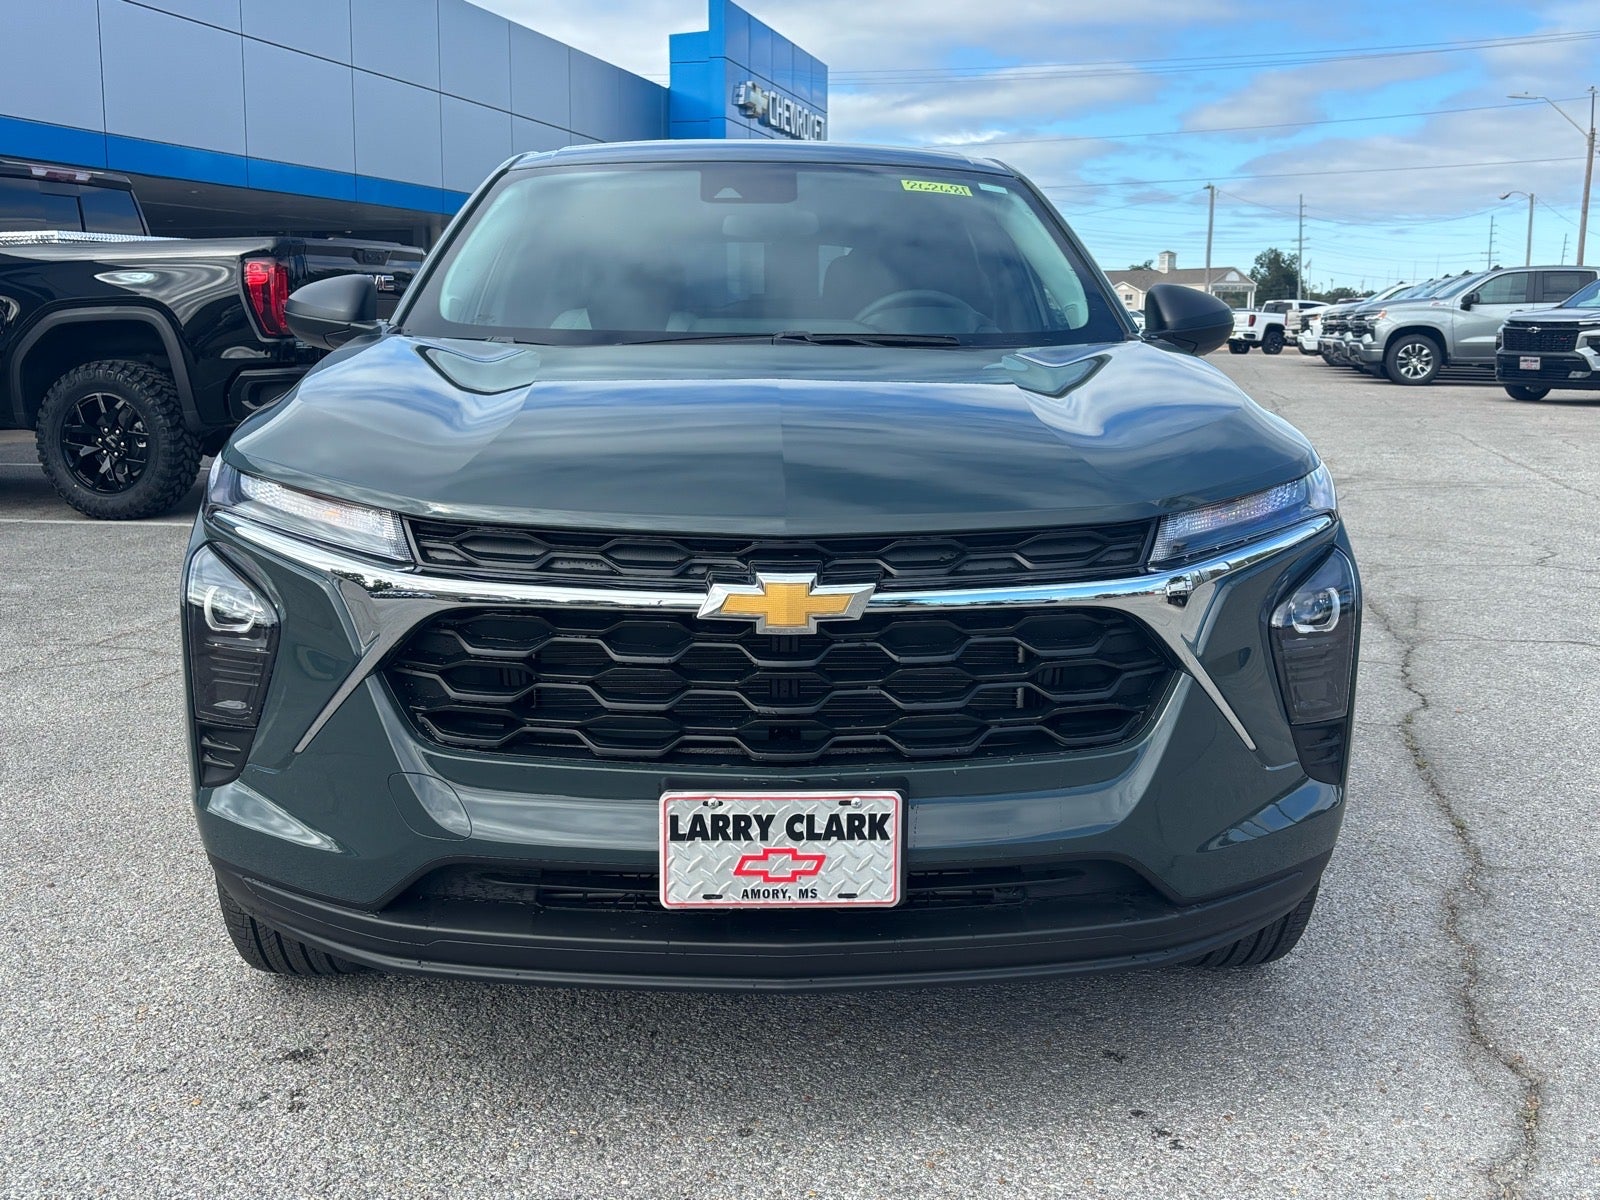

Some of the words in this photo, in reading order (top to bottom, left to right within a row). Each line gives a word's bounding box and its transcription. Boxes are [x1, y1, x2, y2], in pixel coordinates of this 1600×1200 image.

[769, 90, 825, 141] CHEVROLET
[669, 813, 776, 842] LARRY
[785, 813, 891, 841] CLARK
[741, 888, 792, 902] AMORY,
[798, 888, 818, 899] MS
